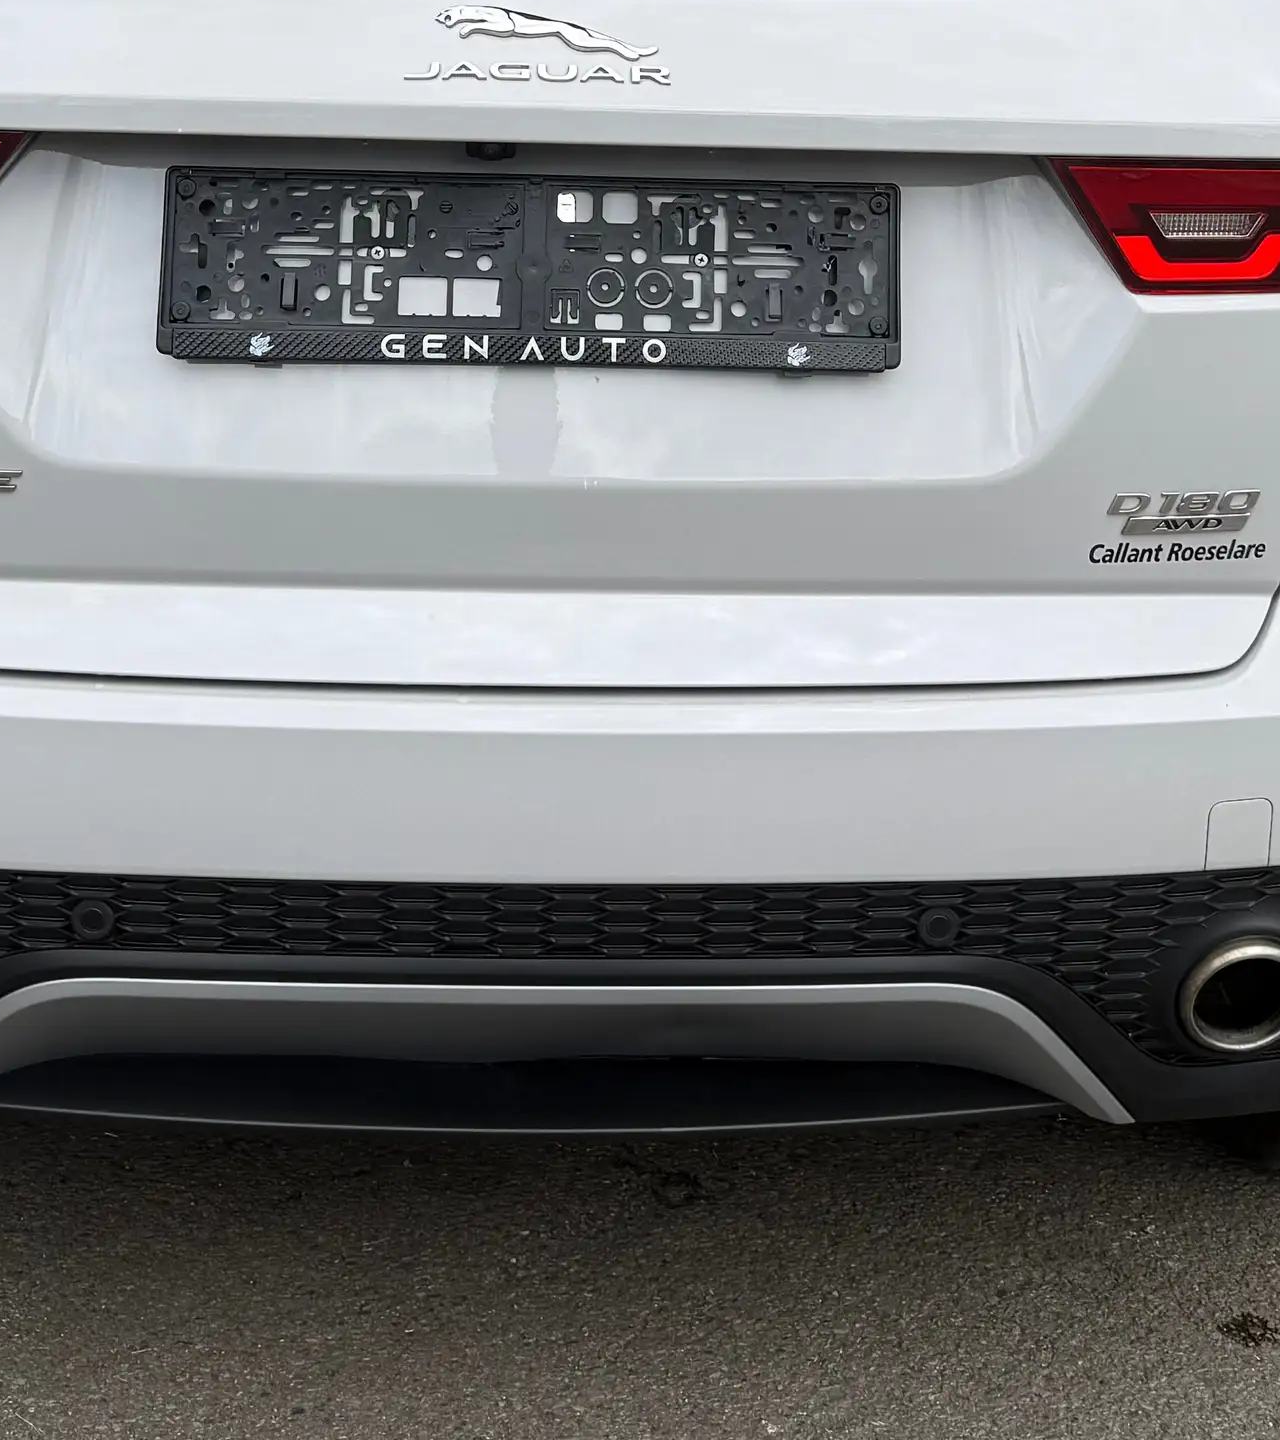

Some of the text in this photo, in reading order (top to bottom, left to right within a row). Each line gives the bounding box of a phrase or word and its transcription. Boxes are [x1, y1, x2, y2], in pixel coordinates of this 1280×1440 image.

[403, 61, 672, 86] JAGUAR
[380, 333, 667, 363] GEN AUTO
[1151, 518, 1223, 532] AWD
[1088, 539, 1266, 564] Callant Roeselare
